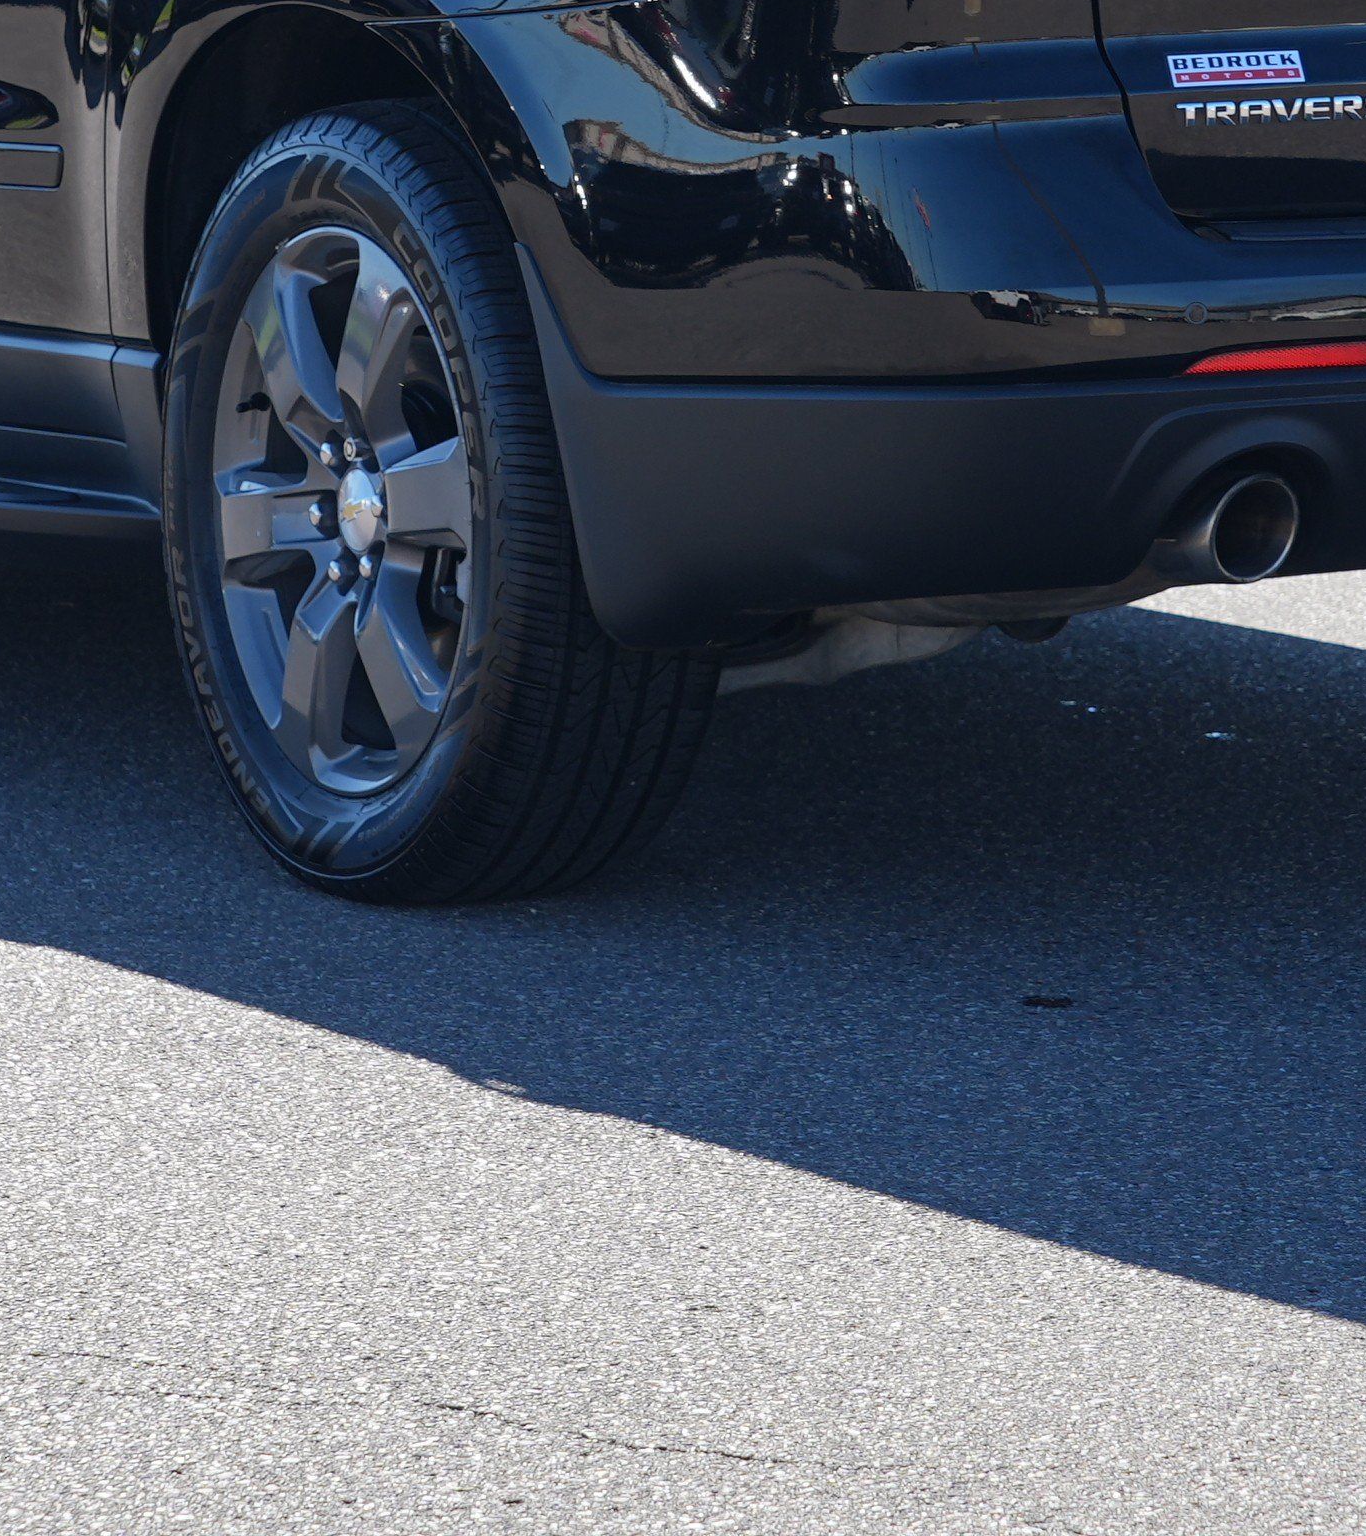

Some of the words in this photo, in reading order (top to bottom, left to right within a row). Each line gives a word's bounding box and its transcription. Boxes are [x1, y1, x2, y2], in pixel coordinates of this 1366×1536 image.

[1172, 53, 1298, 70] BEDROCK
[1179, 70, 1296, 81] MOTORS
[392, 221, 486, 521] COOPER
